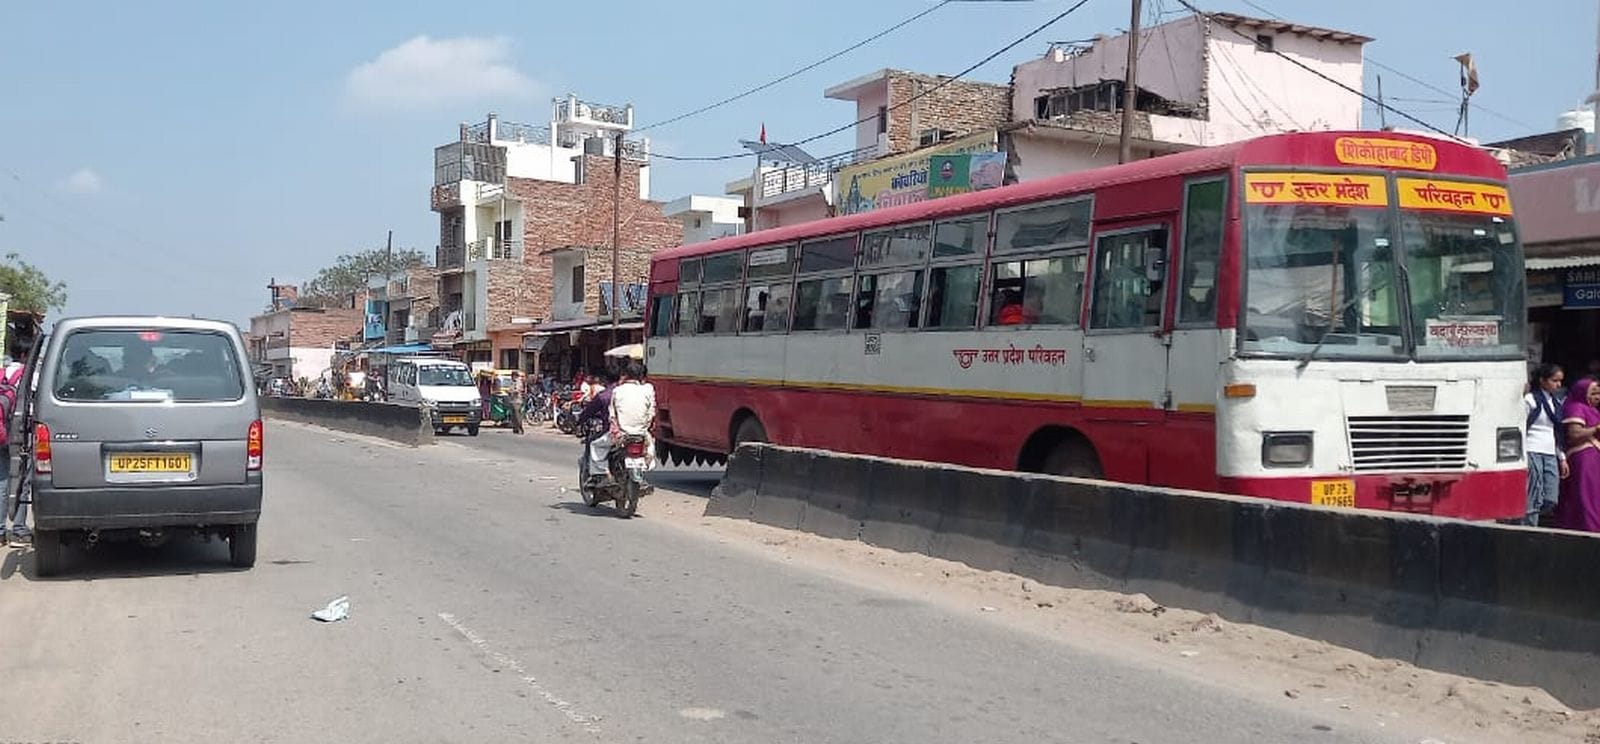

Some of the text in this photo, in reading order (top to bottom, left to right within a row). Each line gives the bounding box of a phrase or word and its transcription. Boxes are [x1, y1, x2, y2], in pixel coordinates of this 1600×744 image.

[1340, 140, 1433, 164] शिकोहाबाद डिपो
[1291, 177, 1370, 201] उत्तर प्रदेश
[1414, 182, 1476, 208] परिवहन
[981, 343, 1066, 366] उत्तर प्रदेश परिवहन
